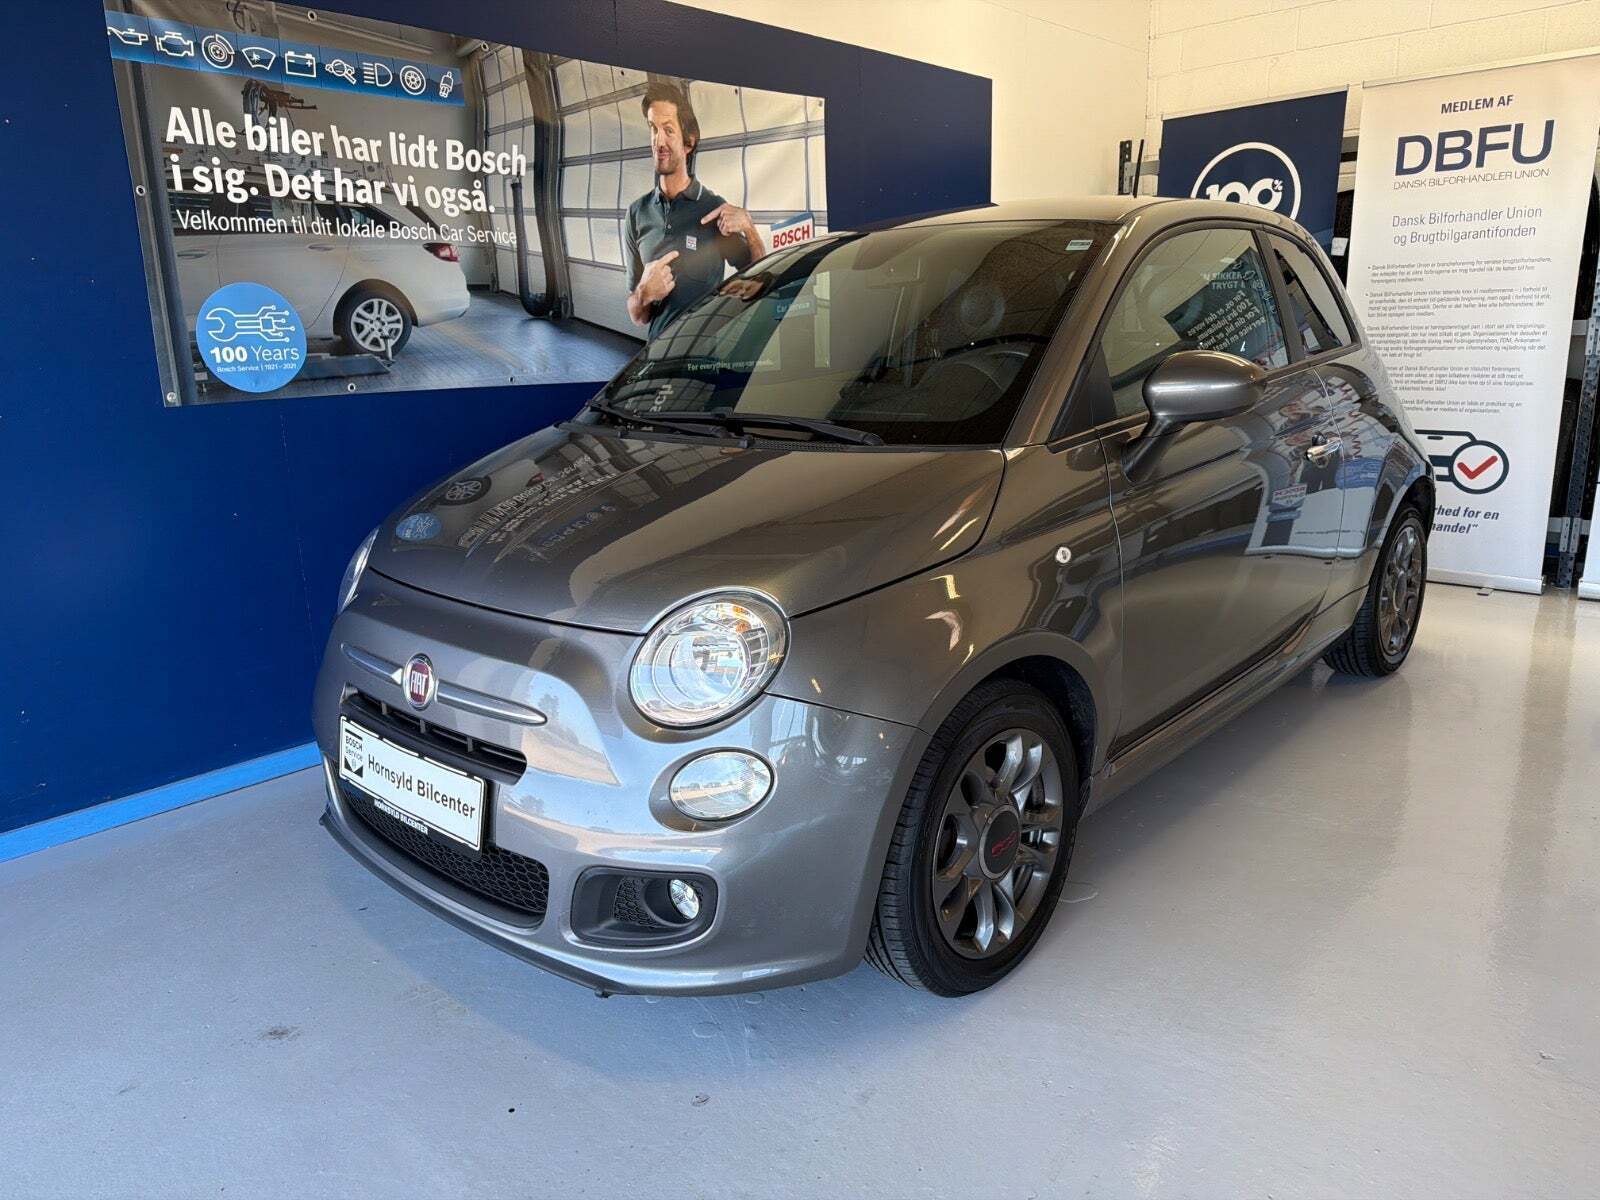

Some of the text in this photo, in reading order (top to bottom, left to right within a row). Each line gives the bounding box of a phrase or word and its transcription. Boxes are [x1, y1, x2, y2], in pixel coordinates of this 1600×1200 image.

[1441, 95, 1514, 114] MEDLEM AF
[165, 105, 527, 177] Alle biler har lidt Bosch
[1395, 120, 1555, 176] DBFU
[171, 153, 496, 218] i sig. Det har vi også.
[1393, 168, 1550, 190] DANSK BILFORHANDLER UNION
[176, 208, 518, 245] Velkommen til dit lokale Bosch Car Service
[1392, 207, 1542, 228] Dansk Bilforhandler Union
[772, 224, 810, 249] BOSCH
[1393, 225, 1536, 246] og Brugtbilgarantifonden
[210, 345, 299, 363] 100 Years
[1463, 507, 1482, 518] for
[1483, 511, 1500, 520] en
[410, 670, 429, 696] FIAT
[345, 736, 363, 751] BOSCH
[345, 746, 363, 761] Service
[368, 754, 475, 818] Hornsyld Bilcenter
[401, 813, 428, 834] BILCENTER
